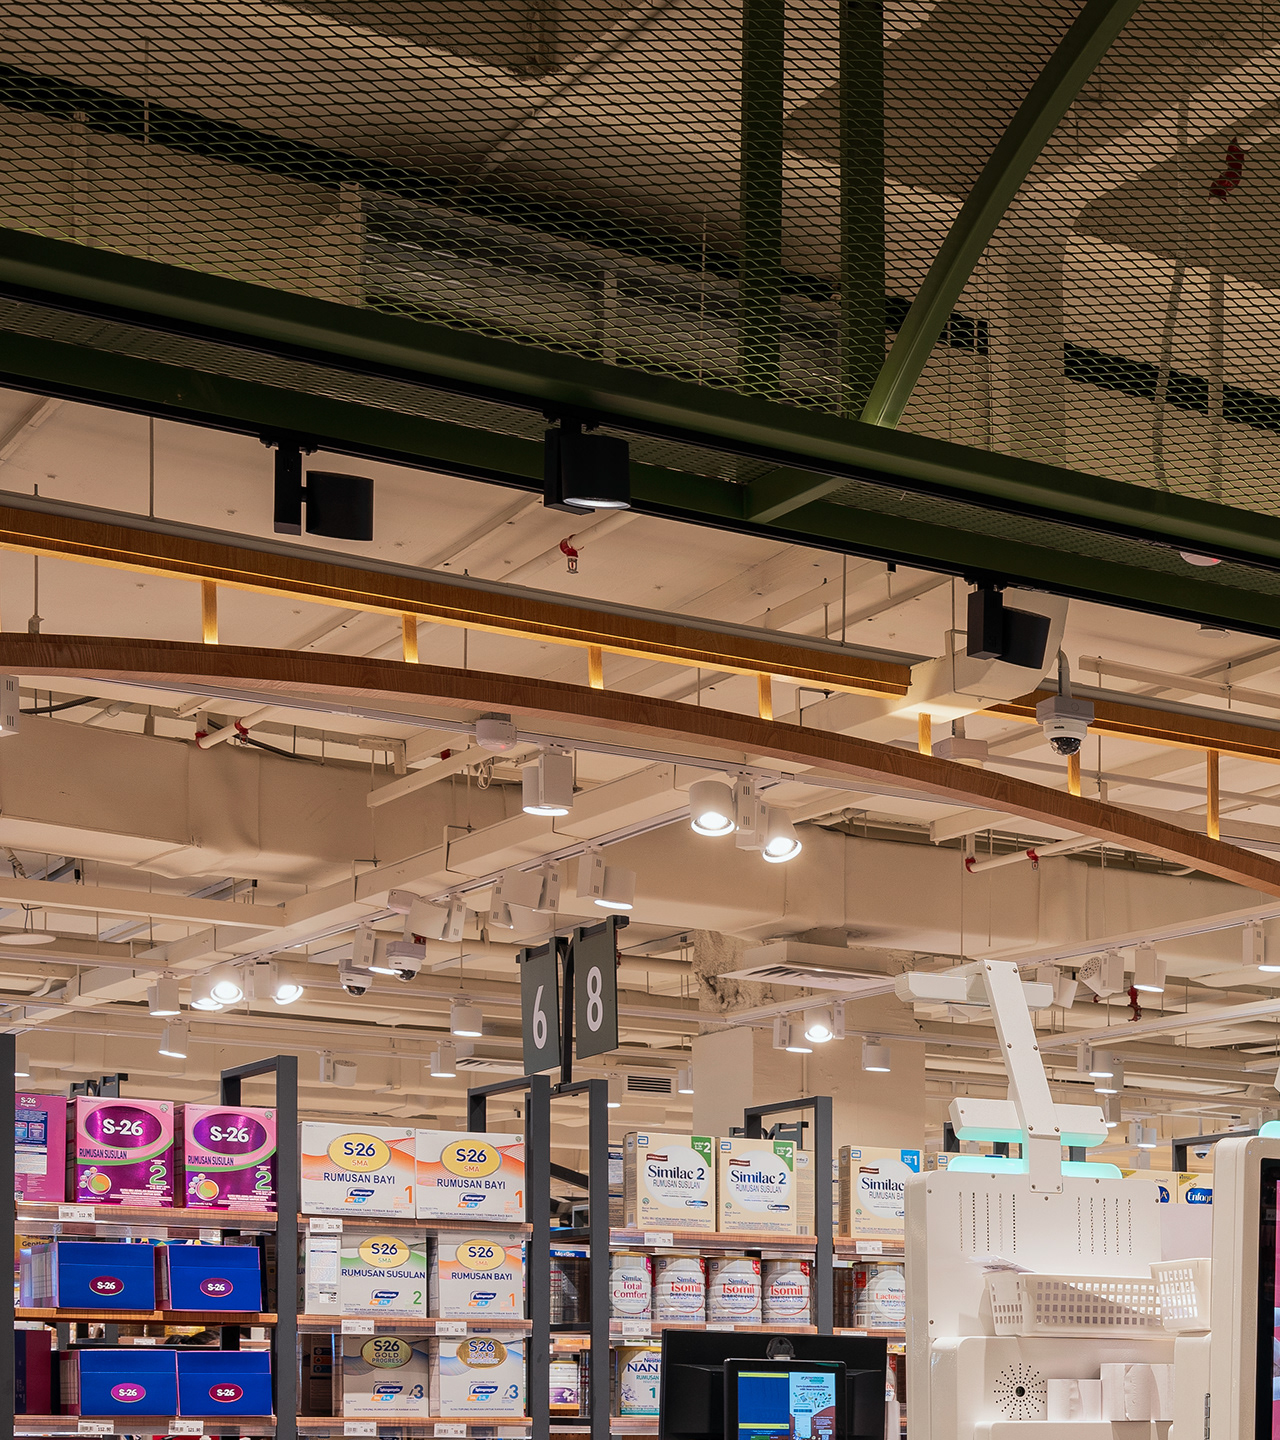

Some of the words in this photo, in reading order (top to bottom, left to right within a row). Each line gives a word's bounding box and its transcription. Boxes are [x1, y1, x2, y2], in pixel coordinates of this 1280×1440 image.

[587, 966, 603, 1032] 8
[533, 985, 547, 1049] 6
[344, 1142, 375, 1156] S-26
[456, 1149, 487, 1163] S-26
[352, 1159, 368, 1167] SMA
[150, 1165, 166, 1185] 2
[324, 1172, 370, 1183] RUMUSAN
[374, 1174, 395, 1184] BAYI
[648, 1165, 693, 1179] Similac
[697, 1168, 704, 1180] 2
[731, 1170, 775, 1184] Similac
[779, 1173, 786, 1184] 2
[256, 1171, 271, 1190] 2
[437, 1178, 481, 1188] RUMUSAN
[485, 1180, 505, 1189] BAYI
[869, 1191, 895, 1200] RUMUSAN
[342, 1269, 384, 1278] RUMUSAN
[387, 1270, 425, 1279] SUSULAN
[622, 1281, 642, 1289] Total
[722, 1284, 754, 1293] Isomil
[614, 1290, 647, 1298] Comfort
[627, 1364, 658, 1372] NAN
[650, 1387, 656, 1398] 1
